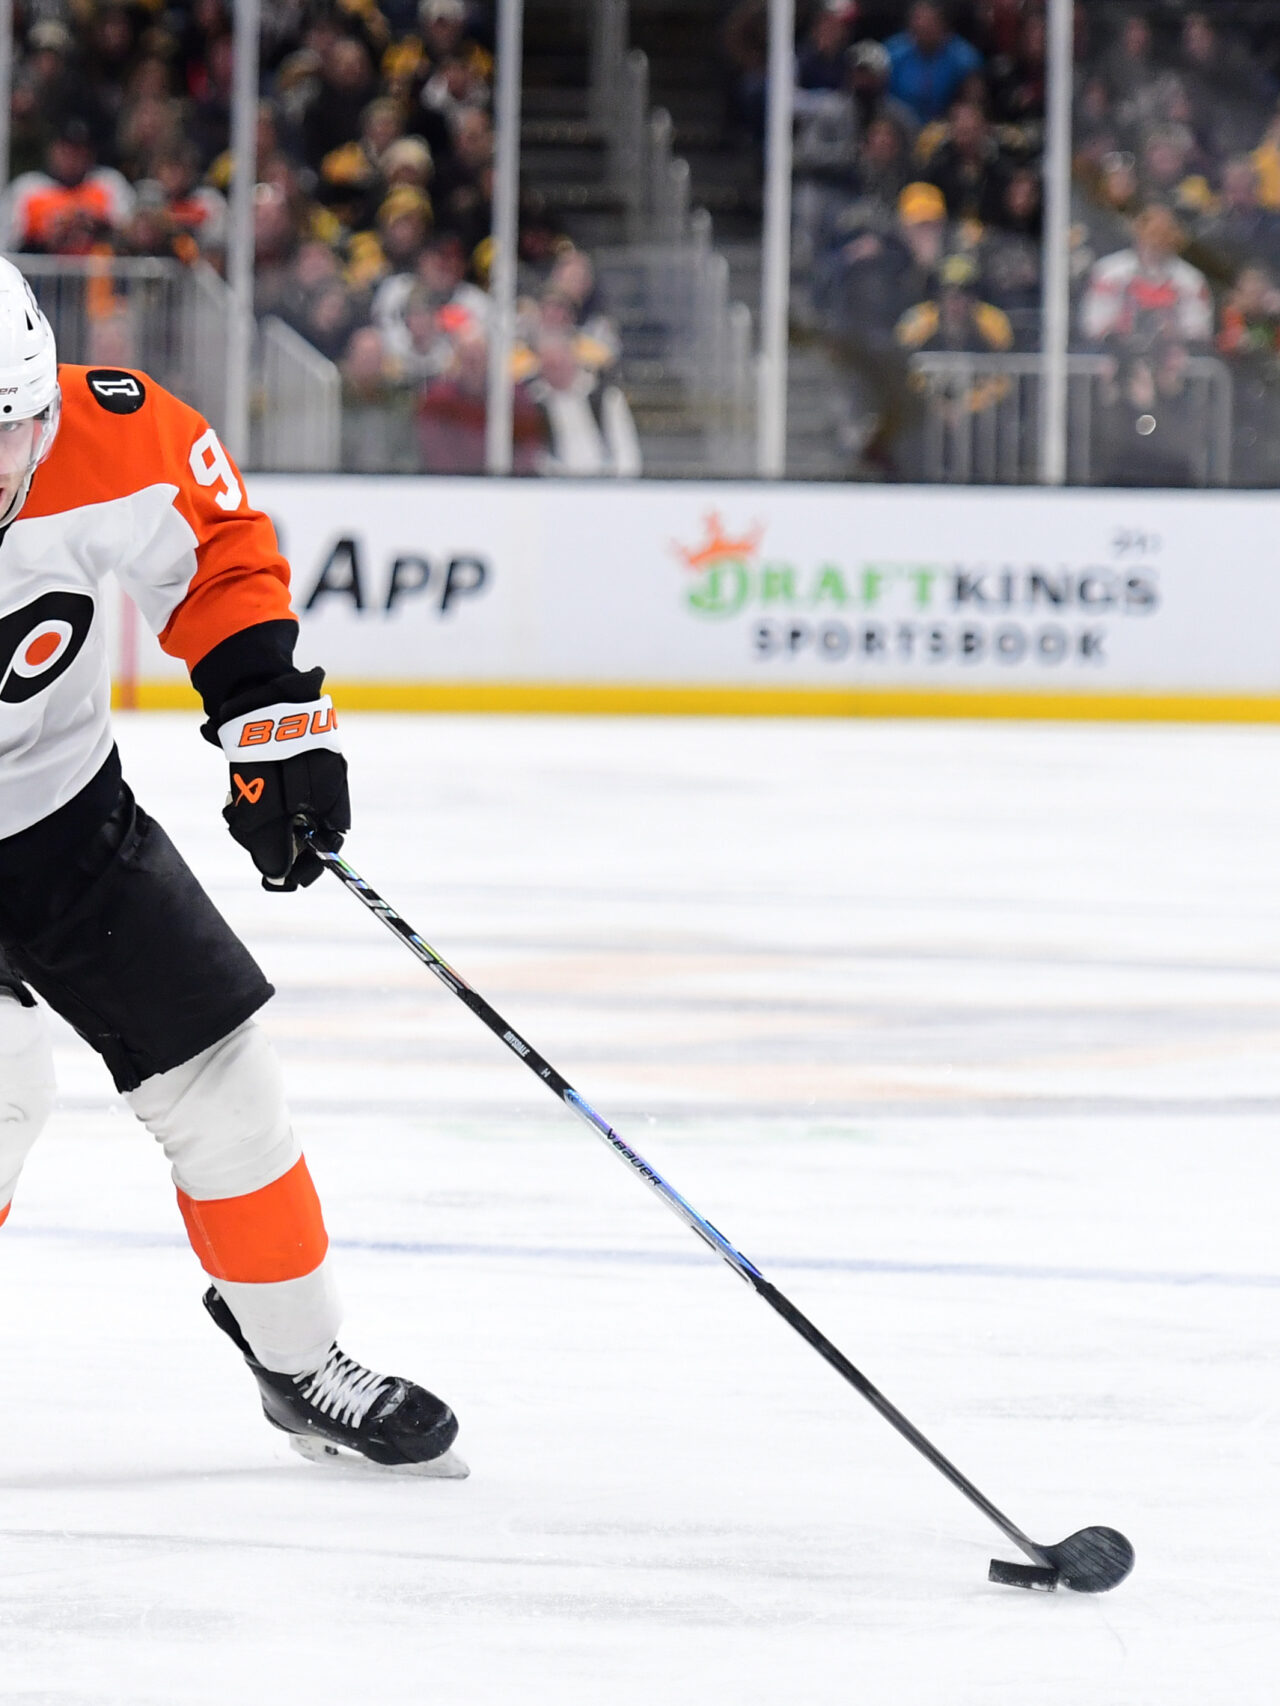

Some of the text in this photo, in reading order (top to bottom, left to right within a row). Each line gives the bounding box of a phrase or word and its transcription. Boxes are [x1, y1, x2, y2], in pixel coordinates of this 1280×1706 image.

[91, 378, 140, 396] 1
[188, 428, 243, 511] 9
[753, 619, 1108, 666] SPORTSBOOK
